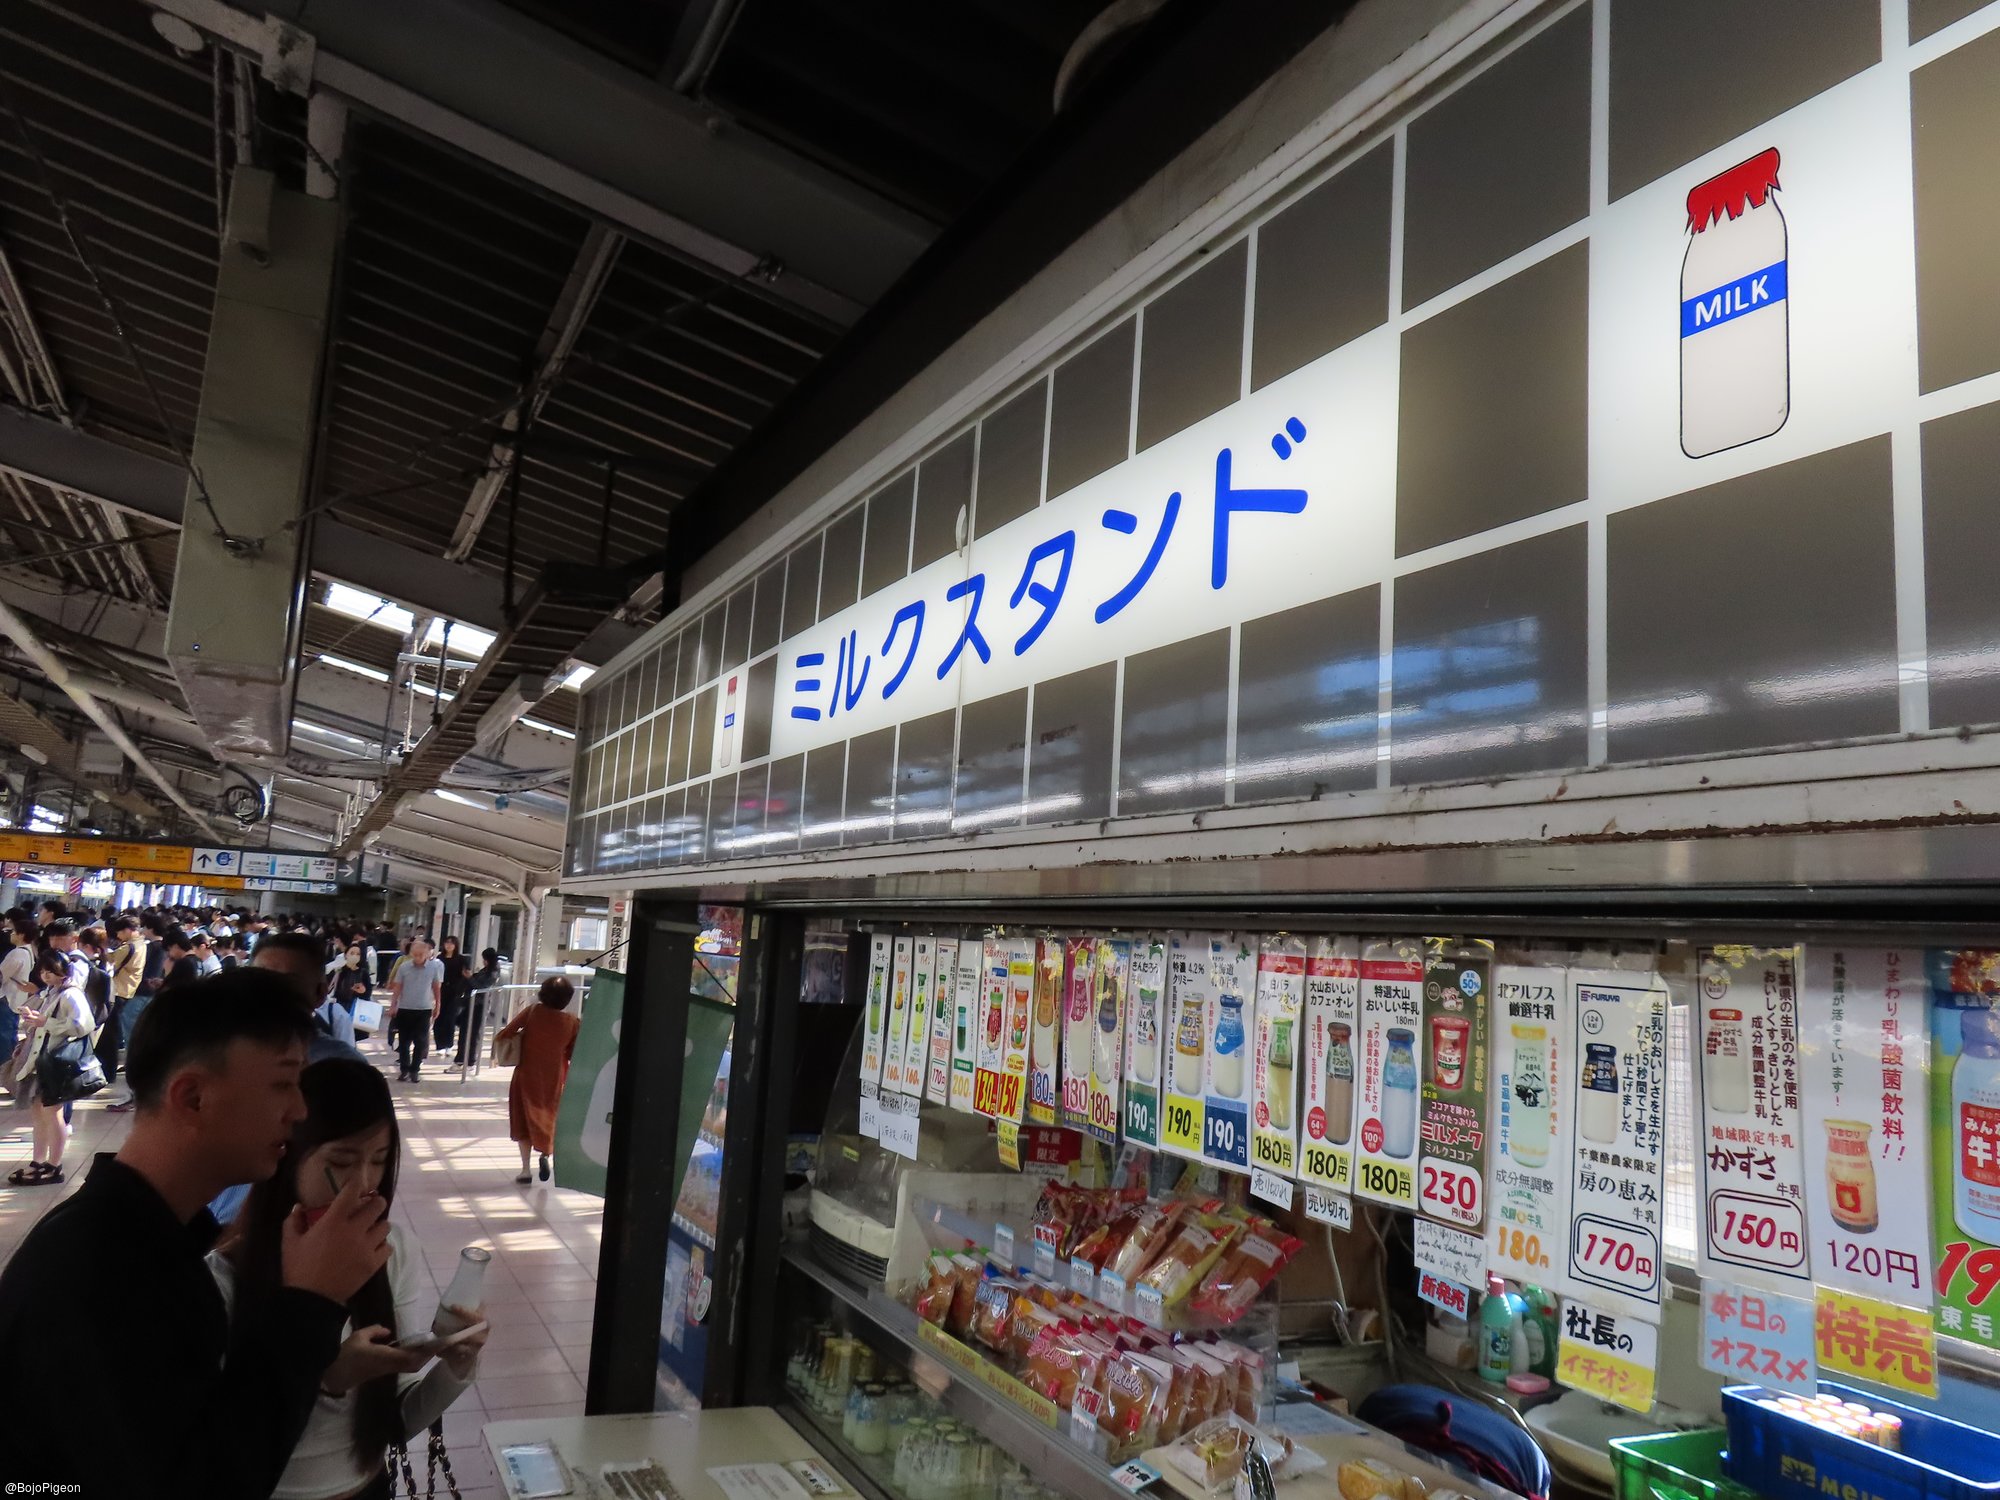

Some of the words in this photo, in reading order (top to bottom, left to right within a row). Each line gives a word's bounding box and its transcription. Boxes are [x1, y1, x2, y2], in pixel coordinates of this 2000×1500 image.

[1695, 274, 1769, 327] MILK
[791, 417, 1309, 721] ミルクスタンド
[1310, 981, 1354, 994] 大山おいしい
[1374, 985, 1410, 999] 特選大山
[1462, 979, 1479, 989] 50%
[1498, 984, 1555, 1000] 北アルプス
[1590, 994, 1620, 1002] FURUYA
[1311, 995, 1353, 1008] カフェ・オ・レ
[1335, 1010, 1353, 1020] 180ml
[1366, 999, 1420, 1015] おいしい牛乳
[1509, 1002, 1556, 1020] 厳選牛乳
[1396, 1016, 1417, 1026] 180ml
[1778, 960, 1797, 1109] 千葉県の生乳のみを使用
[1764, 971, 1783, 1127] おいしくすっきりとした
[1649, 1002, 1664, 1156] 生乳のおいしさを生かす
[1751, 1015, 1767, 1119] 成分無調整牛乳
[1064, 1078, 1089, 1111] 180
[1090, 1091, 1115, 1127] 180円
[1622, 1053, 1635, 1132] 仕上げました
[1128, 1101, 1155, 1138] 190円
[1168, 1105, 1200, 1144] 190円
[1431, 1101, 1476, 1118] ココアを味わう
[1208, 1117, 1245, 1158] 190円
[1256, 1136, 1292, 1168] 180円
[1420, 1120, 1483, 1151] ミルメーク
[1425, 1142, 1474, 1162] ミルクココア
[1711, 1125, 1794, 1149] 地域限定牛乳
[1967, 1135, 2000, 1168] 牛
[1307, 1149, 1348, 1182] 180円
[1579, 1148, 1657, 1175] 千葉酪農家限定
[1707, 1145, 1777, 1180] かずさ
[1254, 1174, 1288, 1203] 売り切れ
[1362, 1164, 1411, 1198] 180円
[1423, 1166, 1477, 1211] 230
[1496, 1169, 1555, 1195] 成分無調整
[1579, 1170, 1657, 1205] 房の恵み
[1776, 1182, 1801, 1199] 牛乳
[1308, 1194, 1349, 1221] 売り切れ
[1632, 1206, 1656, 1225] 牛乳
[1499, 1225, 1549, 1268] 180円
[1722, 1210, 1799, 1253] 150円
[1584, 1233, 1652, 1278] 170円
[1827, 1240, 1920, 1289] 120円
[1422, 1274, 1466, 1313] 新発売
[1711, 1289, 1787, 1335] 本日の
[1566, 1306, 1633, 1353] 社長の
[1816, 1299, 1932, 1385] 特売
[1711, 1336, 1809, 1382] オススメ
